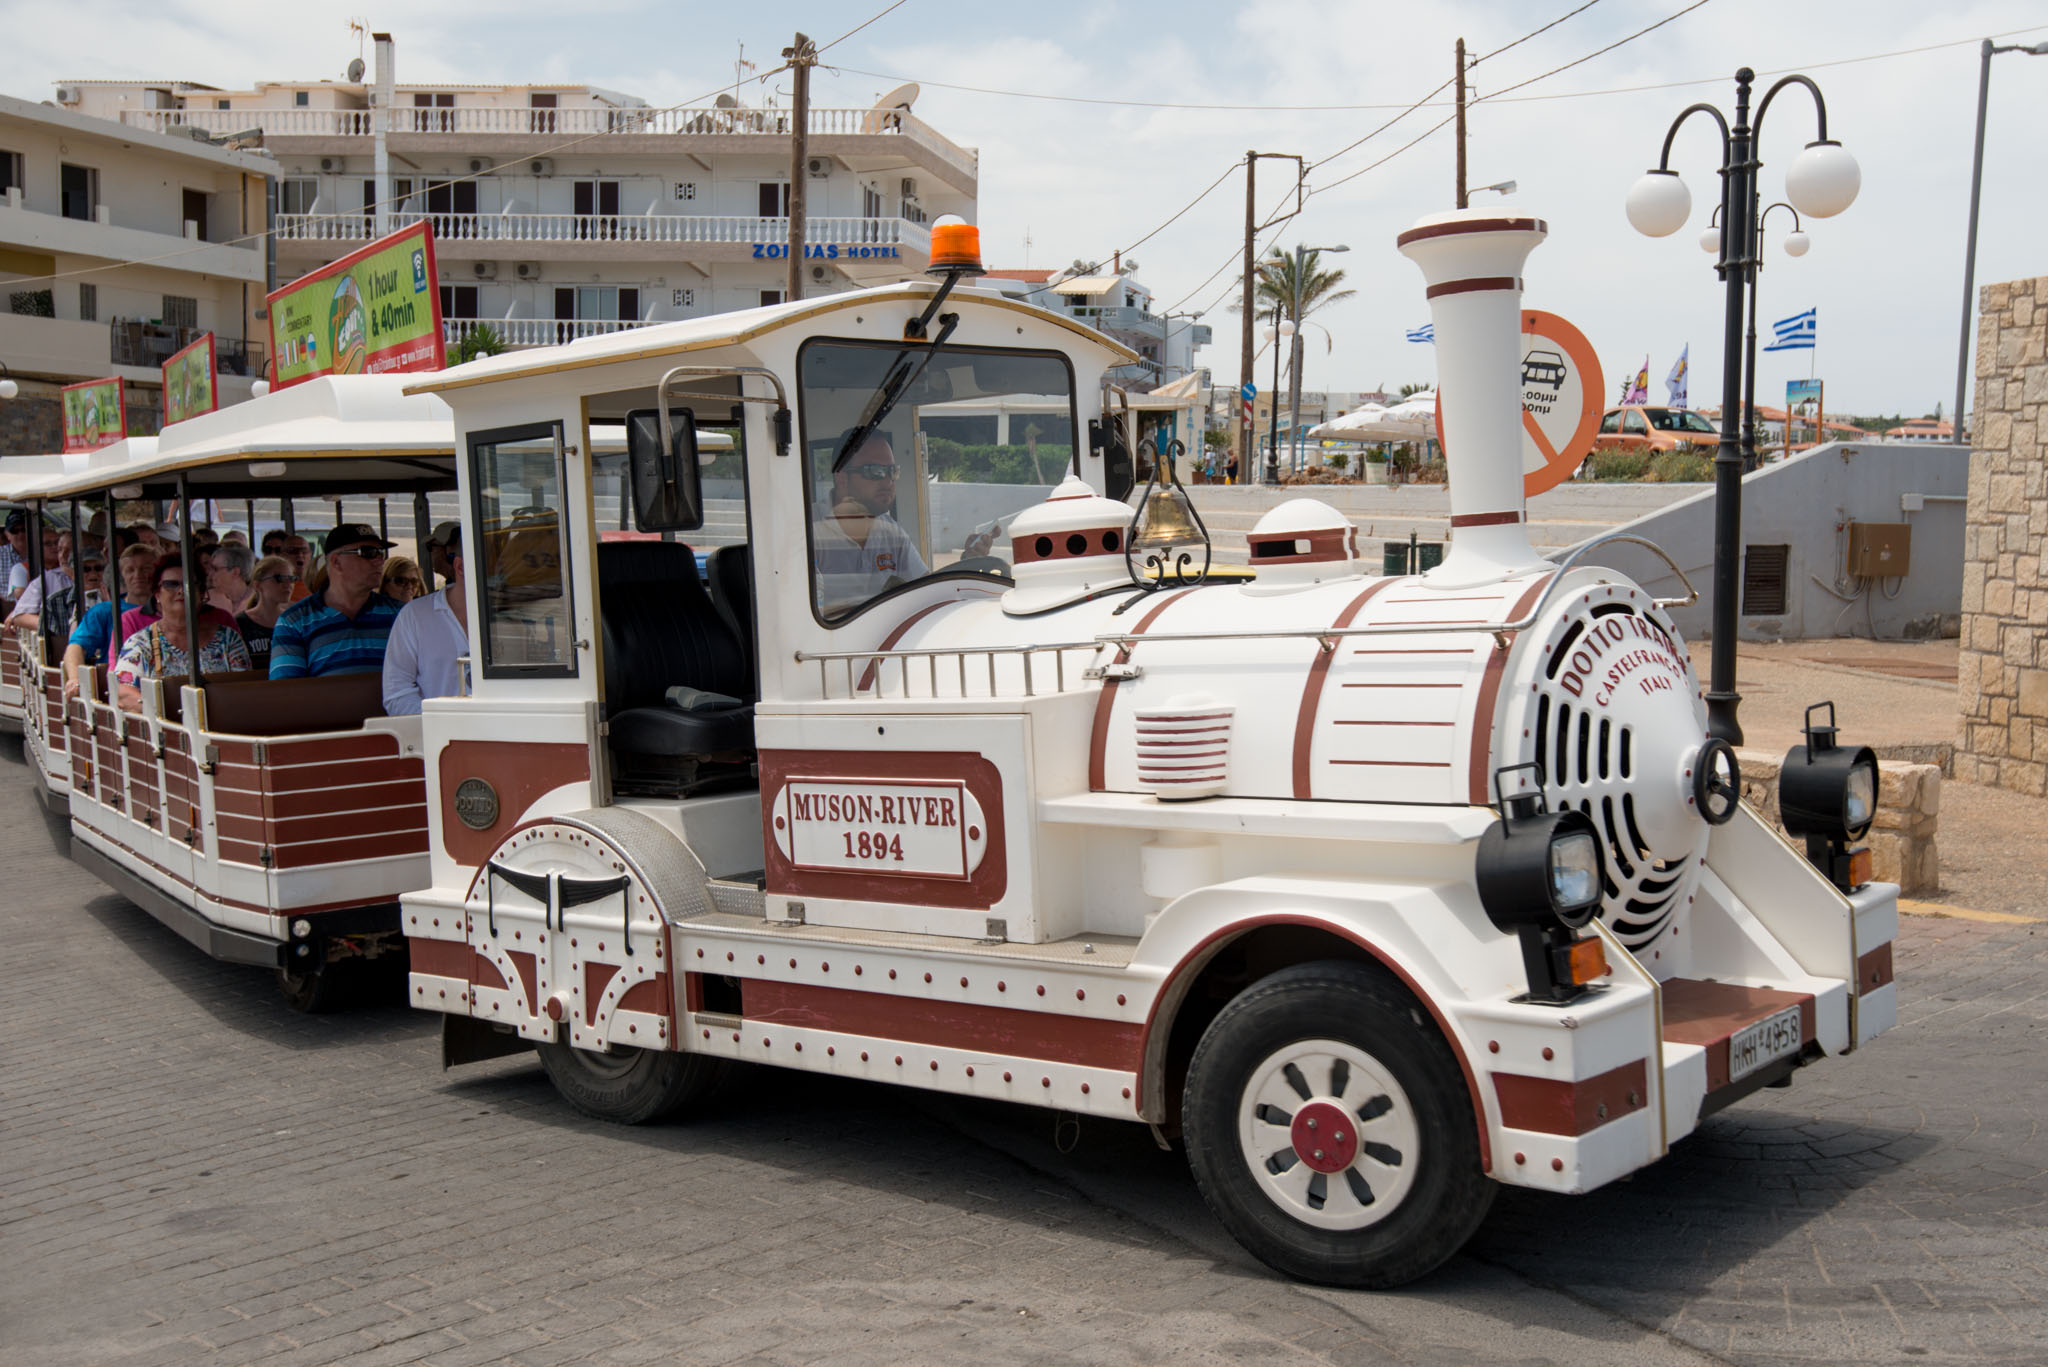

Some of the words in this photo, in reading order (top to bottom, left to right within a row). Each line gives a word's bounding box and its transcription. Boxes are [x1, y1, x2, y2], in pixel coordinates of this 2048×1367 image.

[848, 247, 900, 258] HOTEL
[368, 273, 374, 301] 1
[375, 269, 398, 299] hour
[371, 308, 380, 337] &
[381, 296, 416, 333] 40min
[1522, 391, 1558, 403] :00μμ
[249, 637, 273, 653] YOU'
[1560, 618, 1624, 698] DOTTO
[1595, 649, 1681, 707] CASTELFRANCO
[1639, 675, 1673, 696] ITALY
[842, 831, 904, 862] 1894
